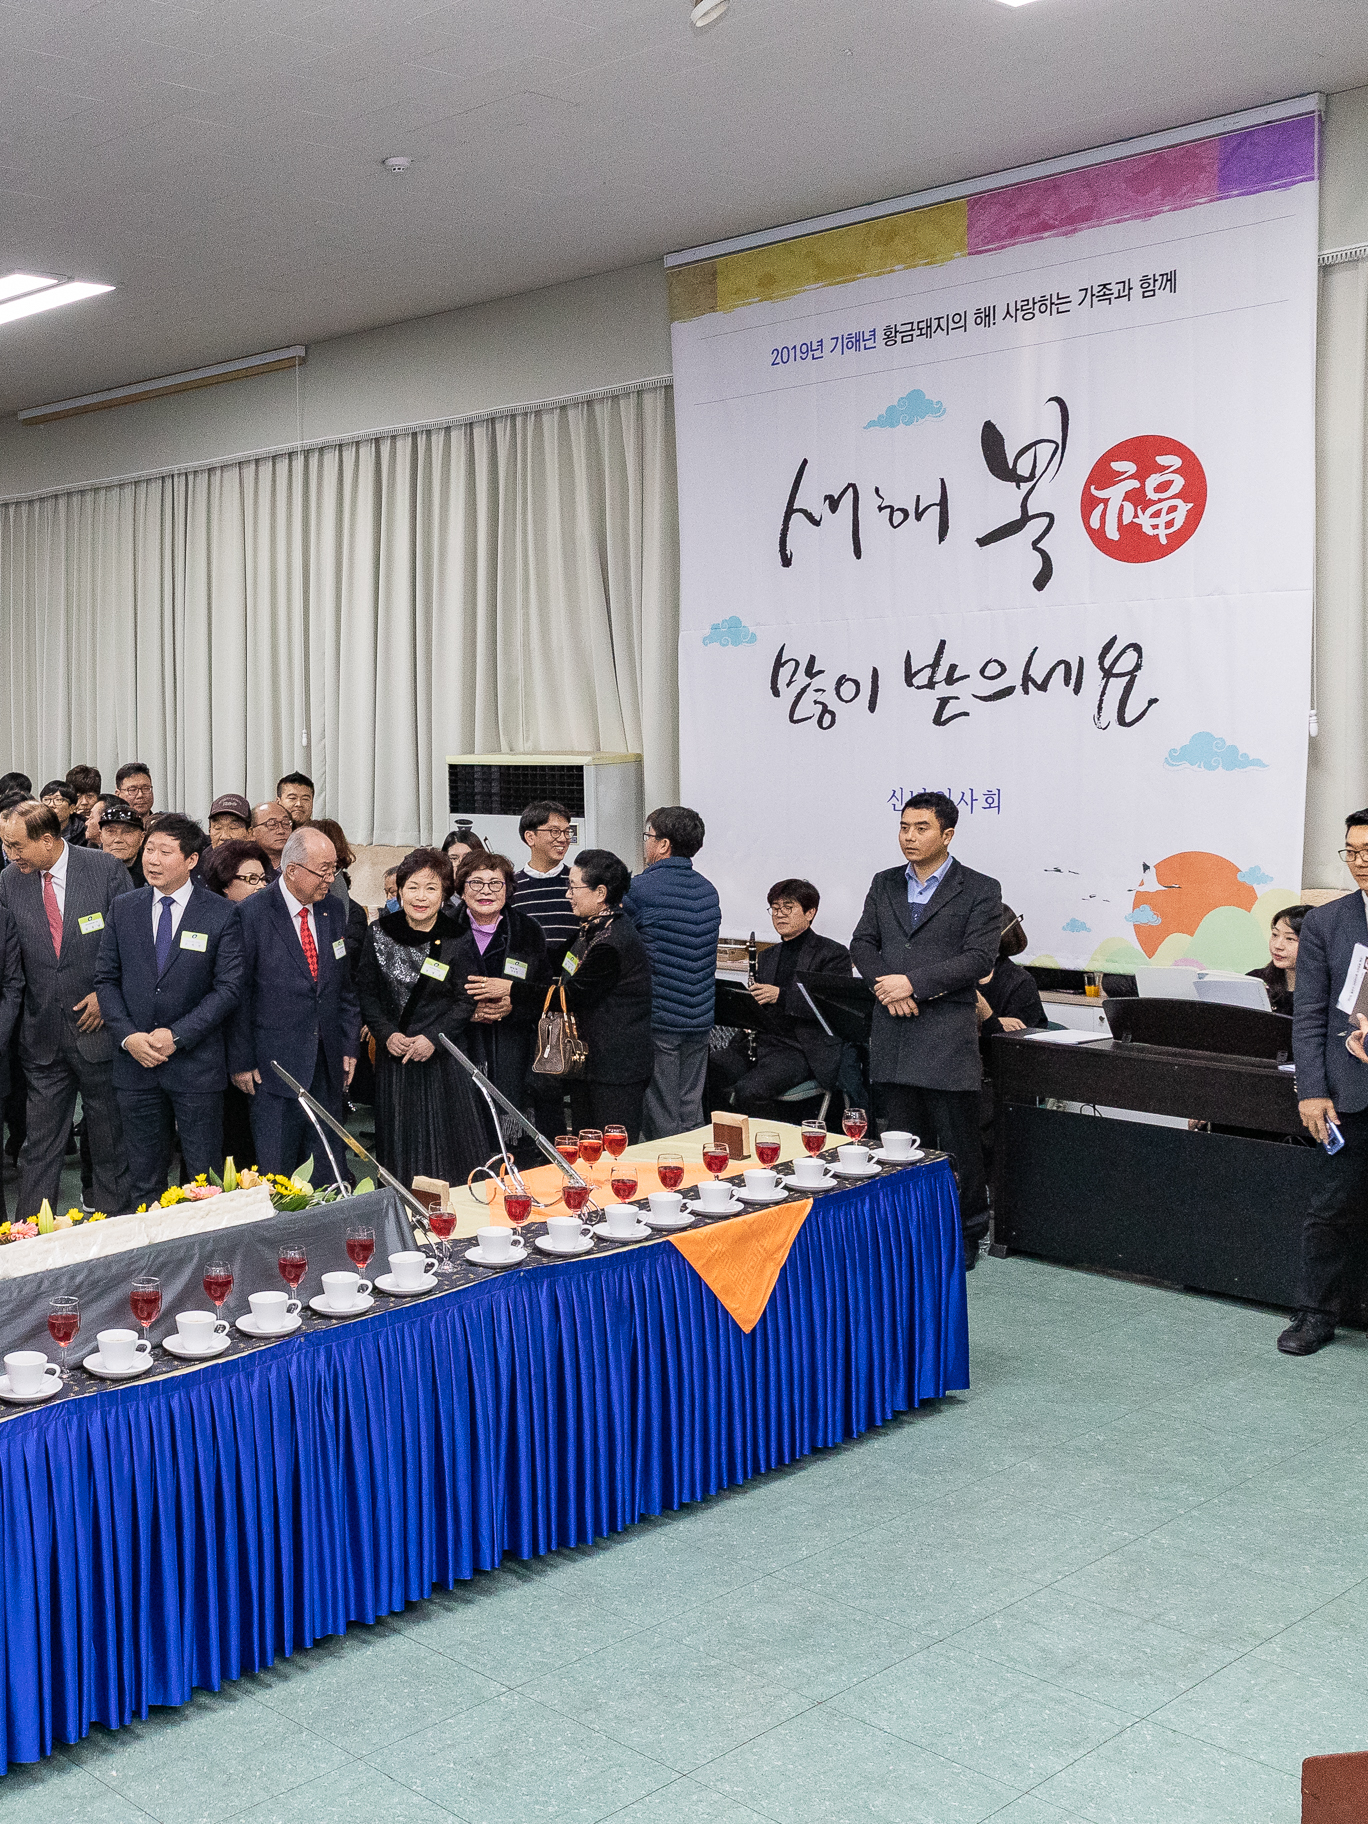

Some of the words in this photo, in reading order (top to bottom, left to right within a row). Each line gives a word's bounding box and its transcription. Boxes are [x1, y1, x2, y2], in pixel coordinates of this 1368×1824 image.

[770, 338, 825, 366] 2019년
[829, 327, 878, 357] 기해년
[882, 310, 968, 347] 황금돼지의
[974, 305, 997, 329] 해!
[1001, 291, 1073, 323] 사랑하는
[1077, 277, 1134, 309] 가족과
[1138, 269, 1178, 299] 함께
[779, 457, 950, 568] 새해
[975, 395, 1070, 592] 복
[1089, 454, 1195, 545] 福
[770, 643, 880, 731] 많이
[904, 635, 1160, 730] 받으세요
